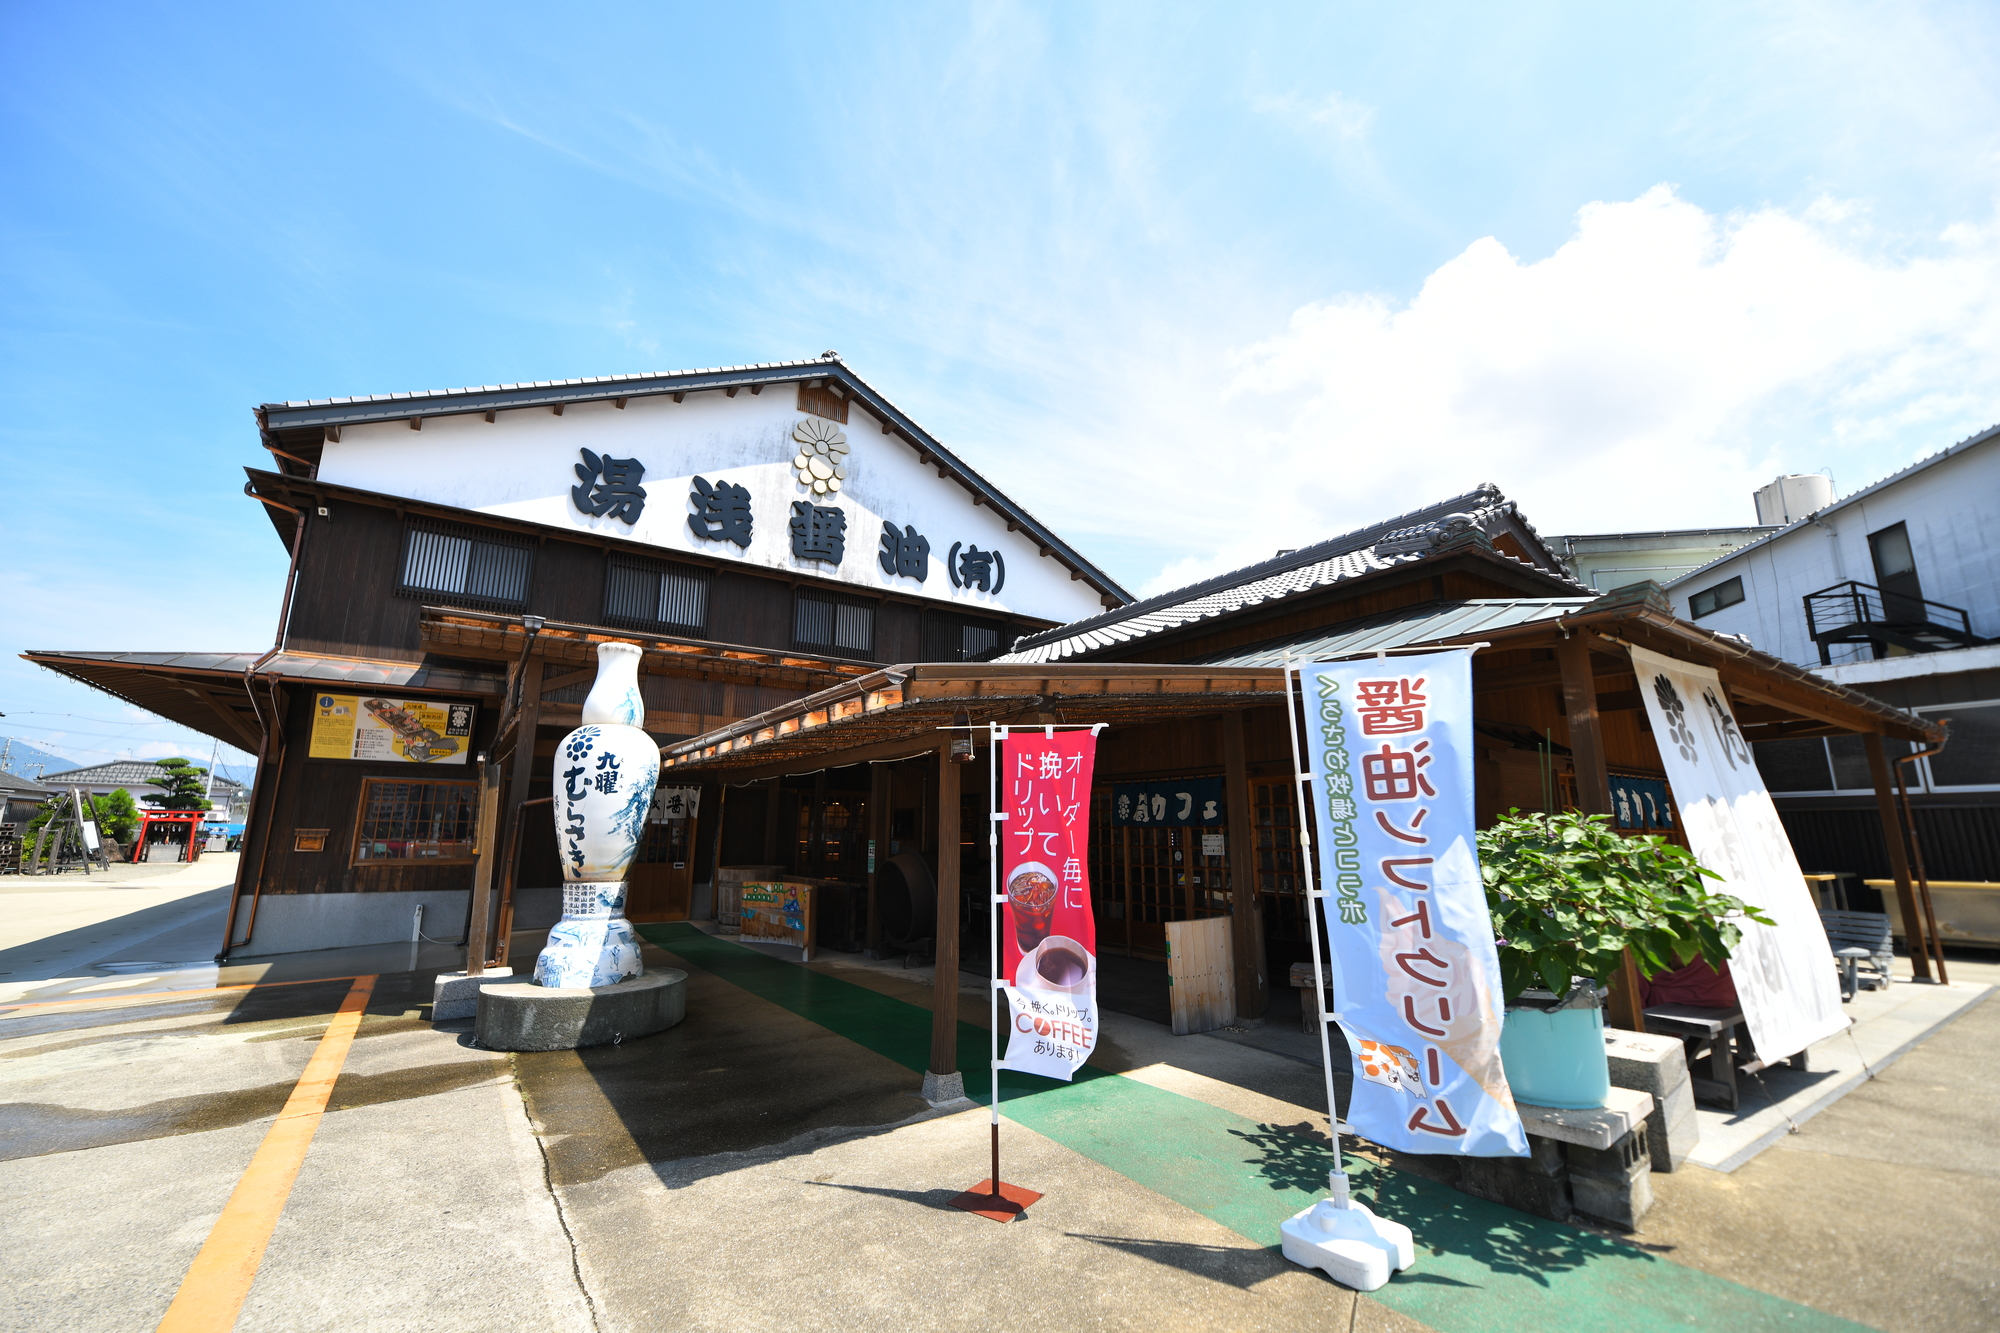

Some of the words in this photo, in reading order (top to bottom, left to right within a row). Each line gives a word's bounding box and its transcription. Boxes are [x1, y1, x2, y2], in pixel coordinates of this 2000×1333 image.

[562, 765, 593, 878] むらさき
[594, 751, 620, 796] 九曜
[1014, 753, 1035, 856] ドリップ
[1037, 751, 1063, 857] 挽いて
[1062, 752, 1084, 909] オーダー毎に
[1015, 1013, 1092, 1049] COFFEE
